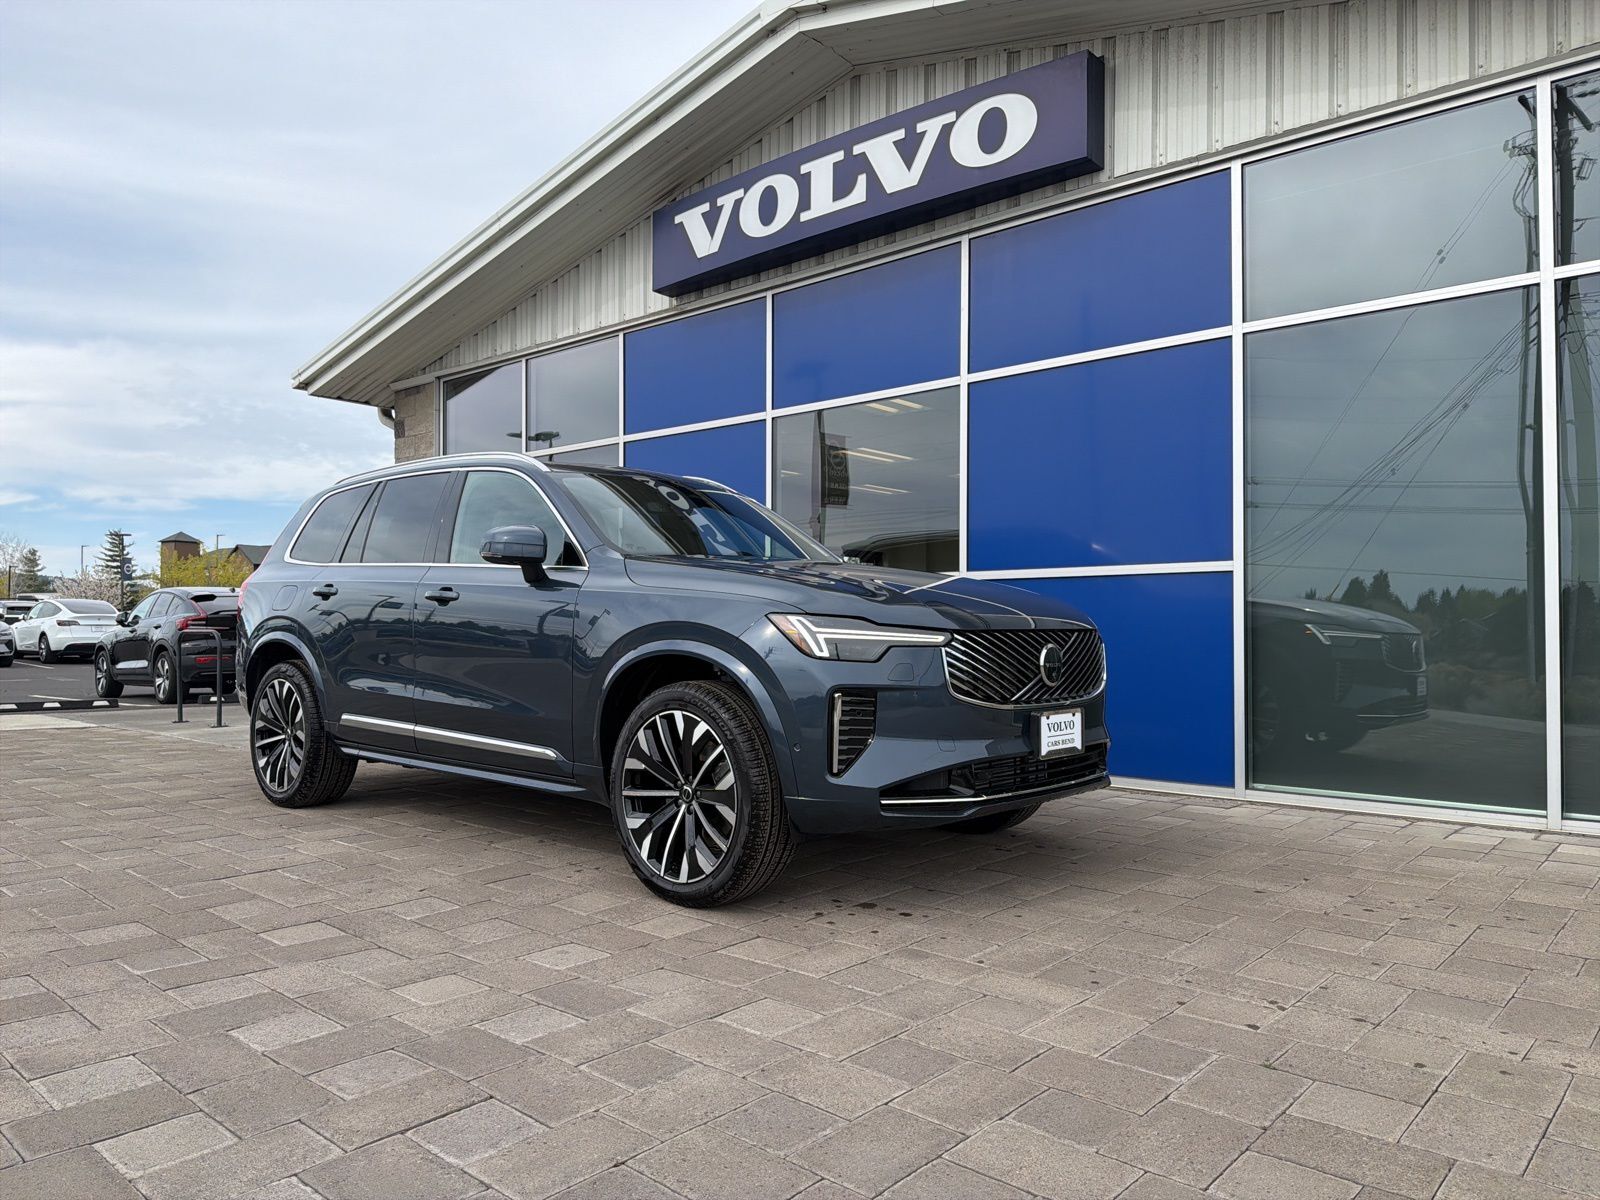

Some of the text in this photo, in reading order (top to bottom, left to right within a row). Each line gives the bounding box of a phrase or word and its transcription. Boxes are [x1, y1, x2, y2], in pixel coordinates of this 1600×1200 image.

[674, 93, 1038, 258] VOLVO
[684, 696, 734, 740] SCORPION
[1046, 720, 1075, 733] VOLVO
[1047, 740, 1061, 748] CARS
